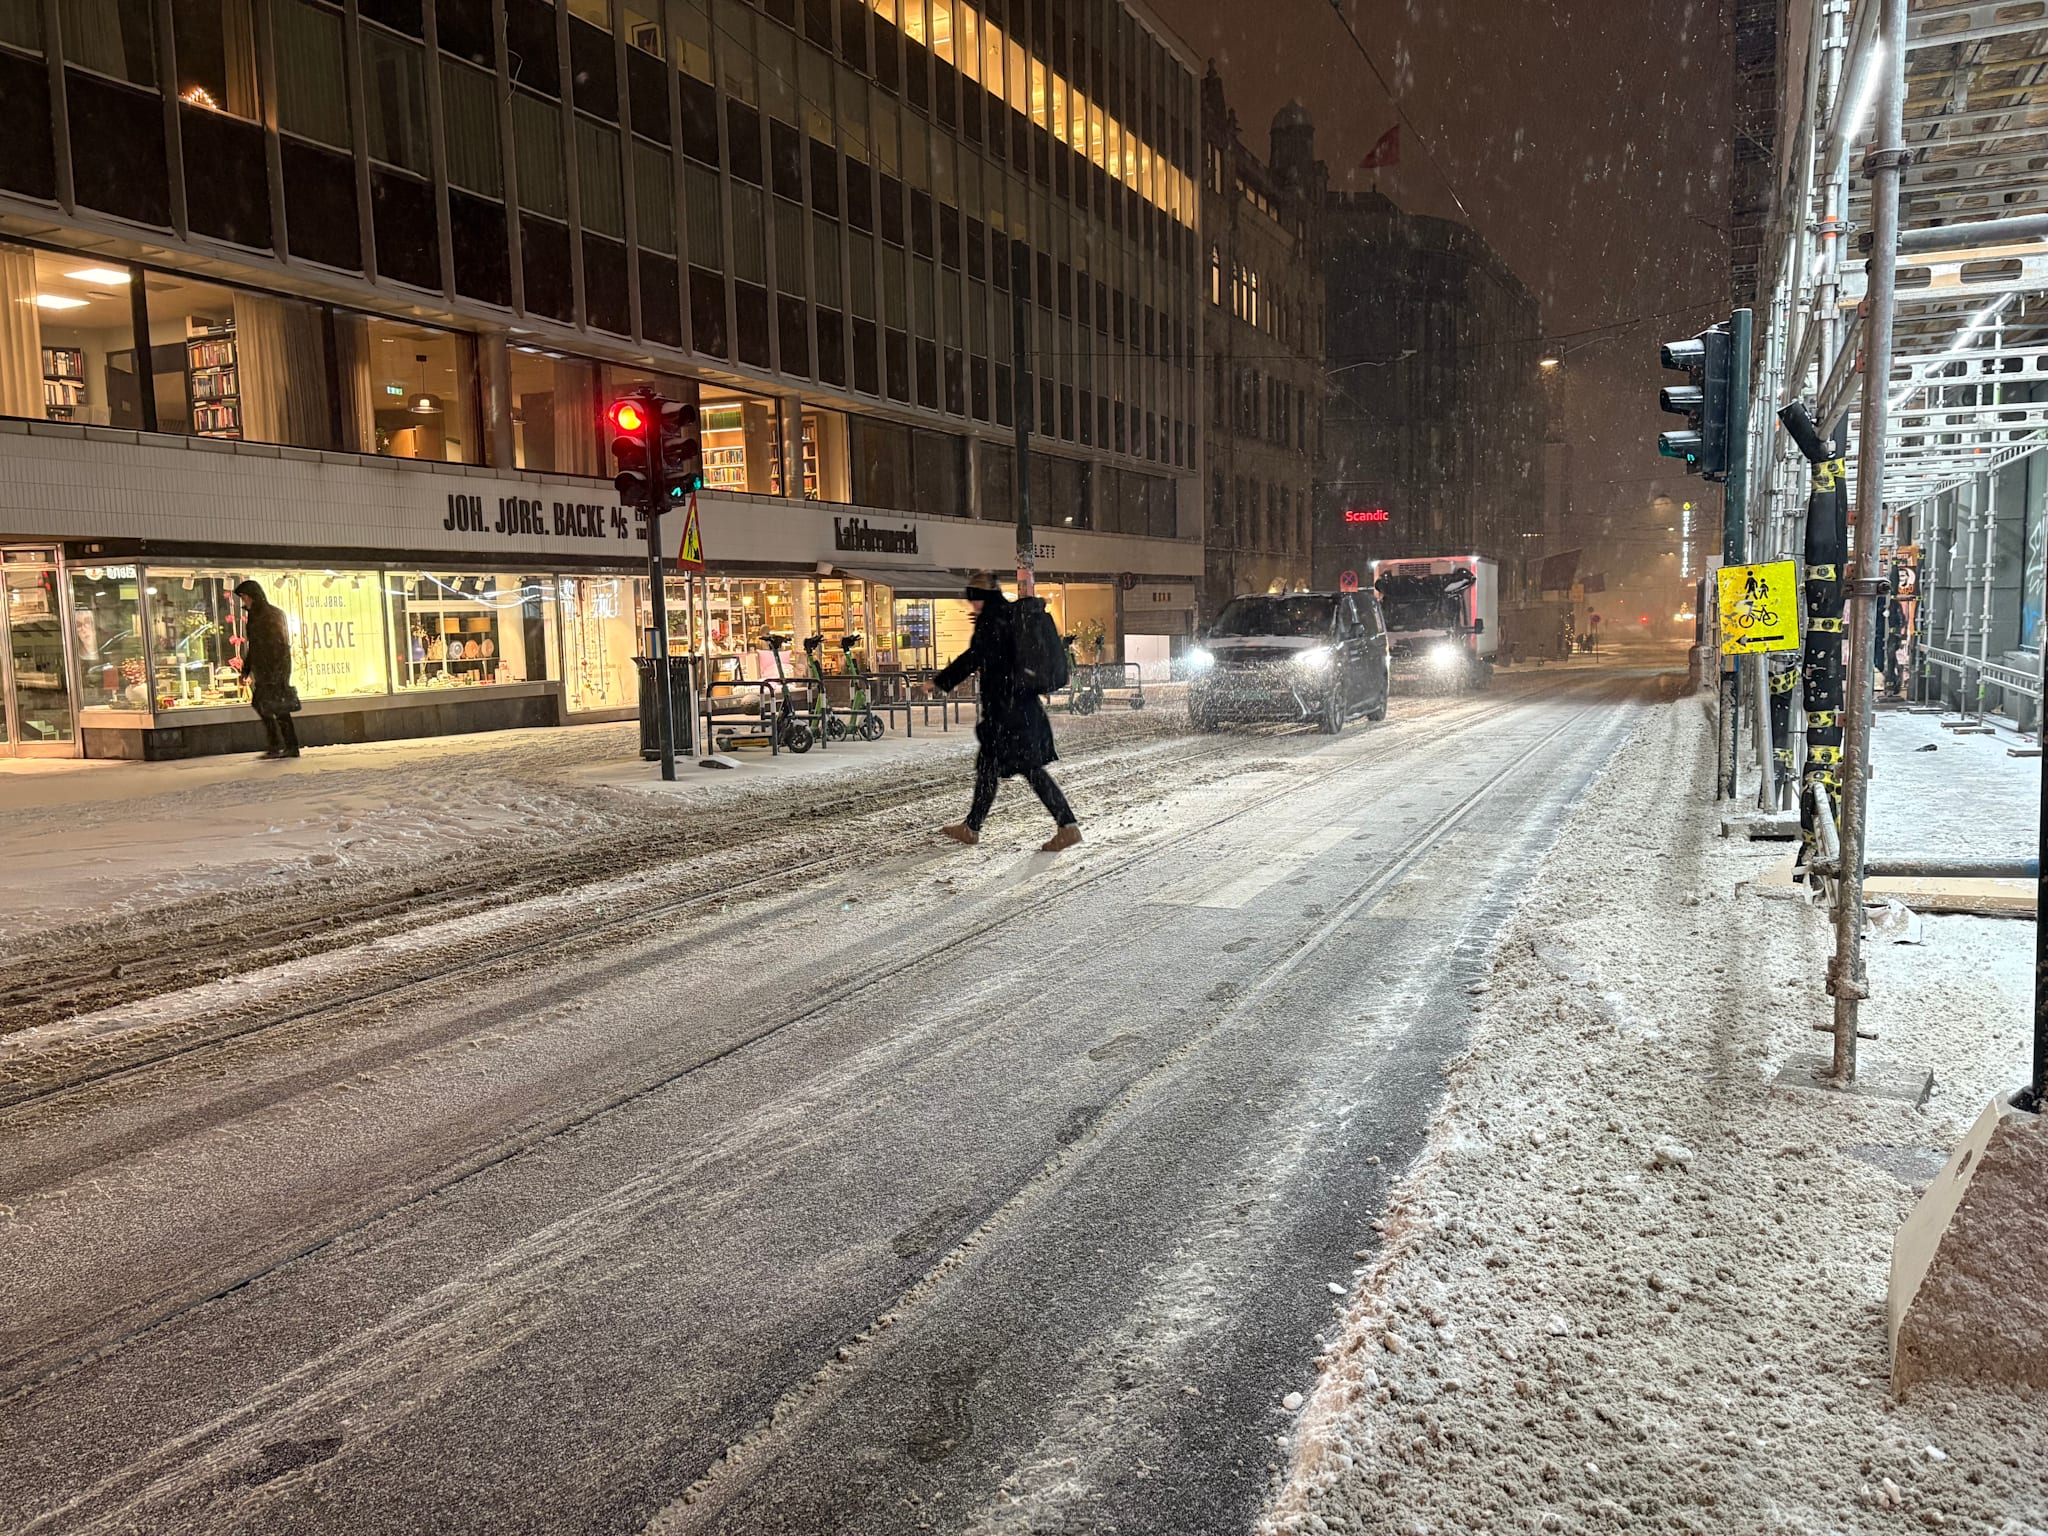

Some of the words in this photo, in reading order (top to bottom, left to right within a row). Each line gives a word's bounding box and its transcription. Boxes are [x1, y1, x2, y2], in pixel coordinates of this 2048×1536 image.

[444, 494, 490, 532] JOH.
[495, 496, 550, 536] JØRG.
[553, 502, 606, 537] BACKE
[1345, 510, 1389, 521] Scandic
[302, 622, 356, 649] BACKE
[316, 662, 351, 676] GRENSEN
